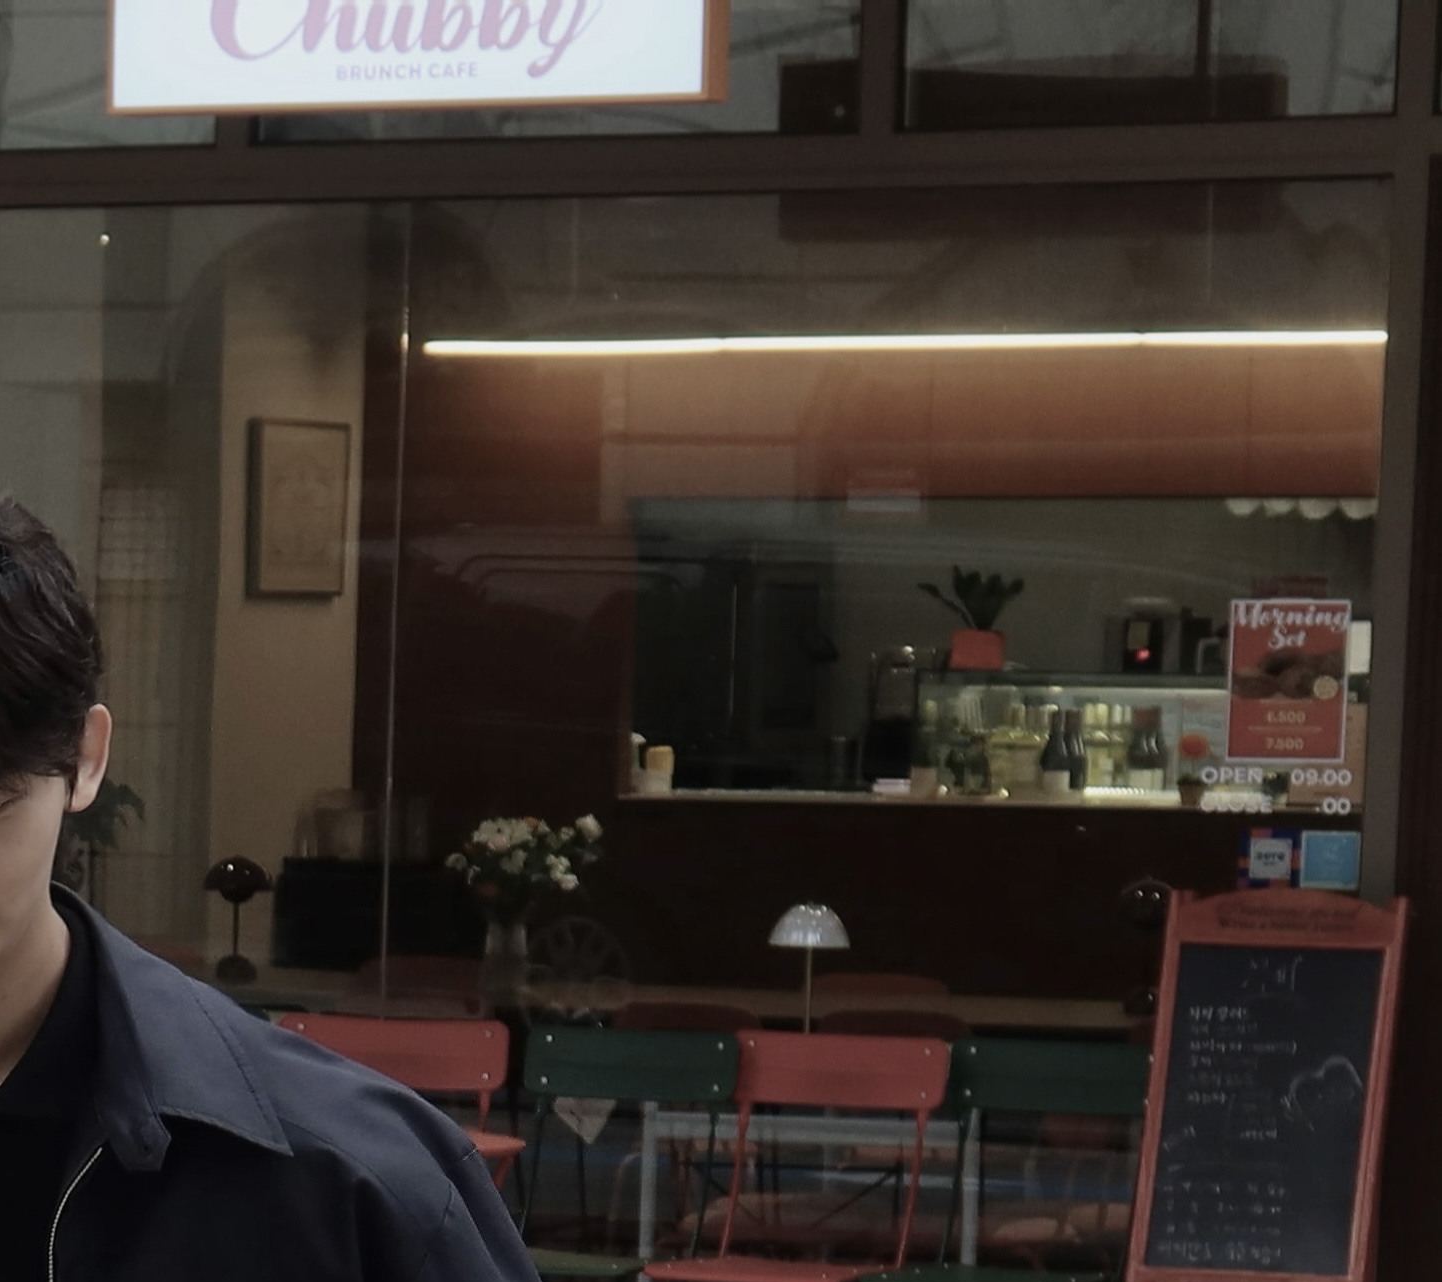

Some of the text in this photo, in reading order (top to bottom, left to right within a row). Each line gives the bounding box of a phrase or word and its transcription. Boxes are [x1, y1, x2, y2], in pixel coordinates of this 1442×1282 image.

[210, 0, 604, 79] Chubby
[335, 61, 479, 82] BRUNCH CAFE
[1234, 601, 1352, 633] Morning
[1268, 624, 1307, 649] Set
[1201, 767, 1263, 784] OPEN
[1200, 793, 1273, 814] CLOSE
